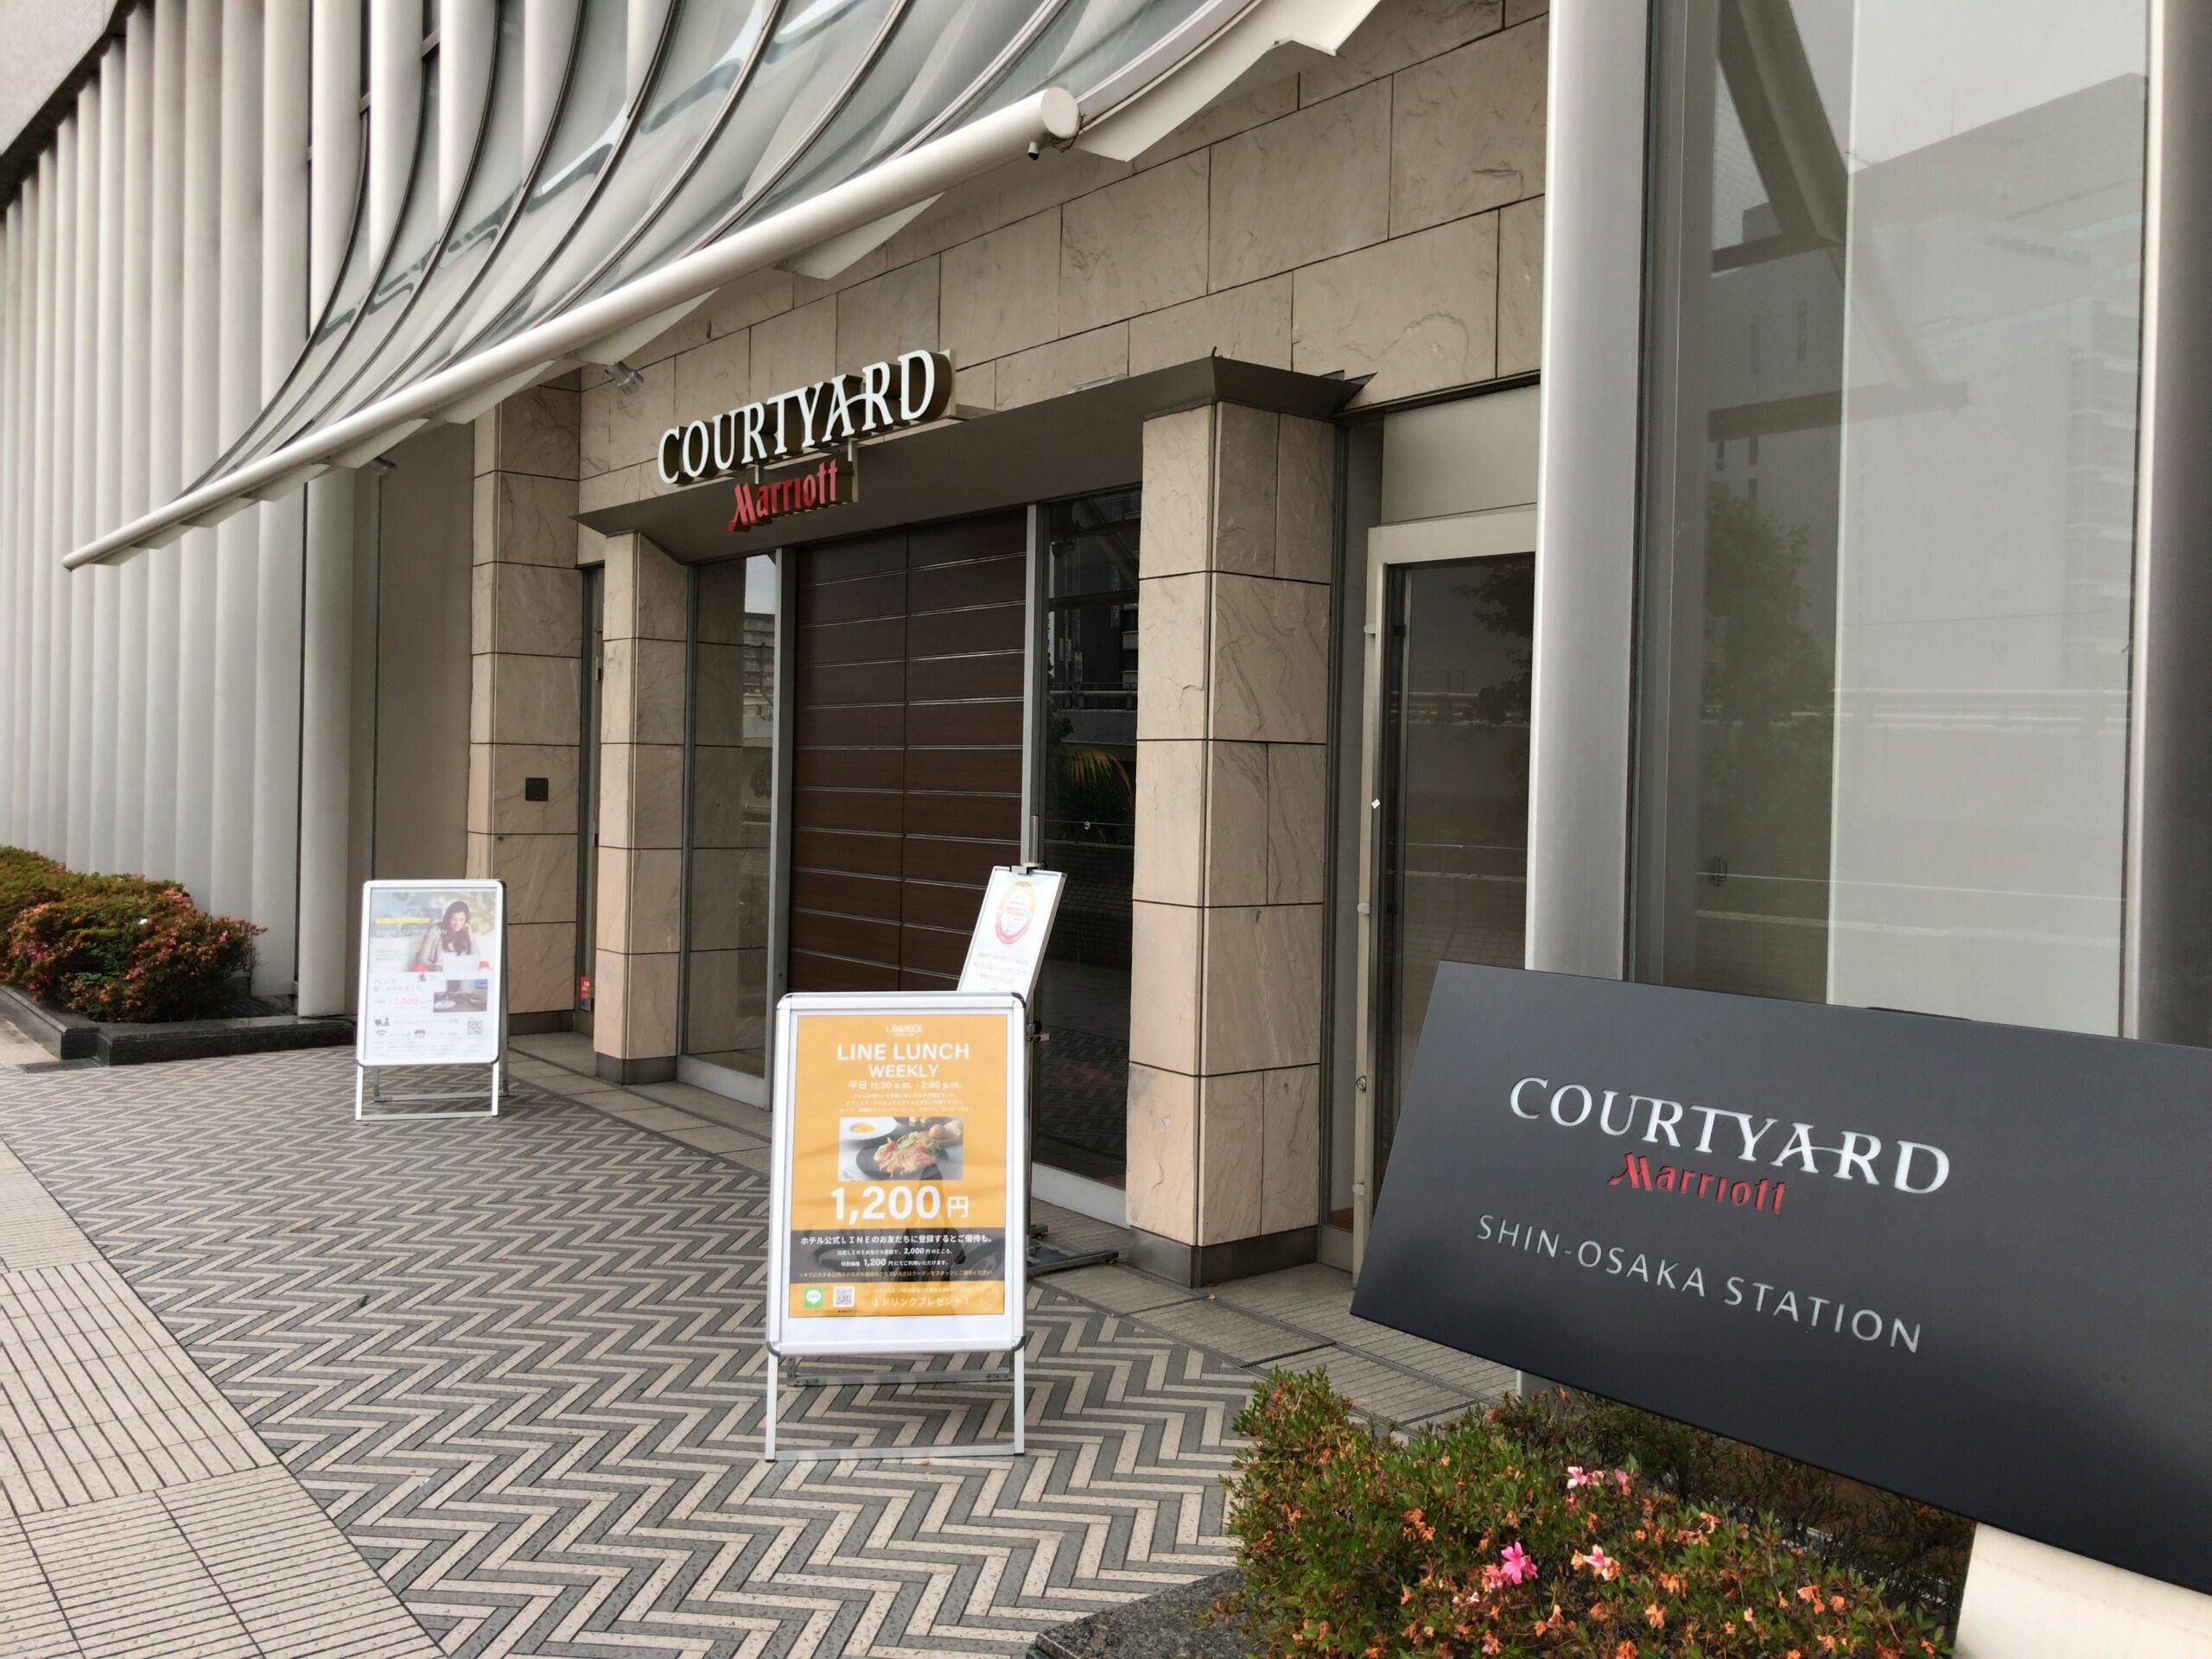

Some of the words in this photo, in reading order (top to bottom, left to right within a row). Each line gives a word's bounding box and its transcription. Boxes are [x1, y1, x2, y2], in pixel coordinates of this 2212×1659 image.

[658, 349, 938, 485] COURTYARD
[727, 458, 839, 532] Marriott
[837, 1044, 887, 1061] LINE
[893, 1043, 969, 1060] LUNCH
[868, 1065, 939, 1077] WEEKLY
[849, 1080, 868, 1090] 平日
[942, 1082, 962, 1090] p.m.
[1510, 1077, 1950, 1194] COURTYARD
[830, 1185, 941, 1225] 1,200
[1607, 1151, 1788, 1215] Marriott
[1476, 1214, 1707, 1298] SHIN-OSAKA
[1724, 1276, 1922, 1355] STATION
